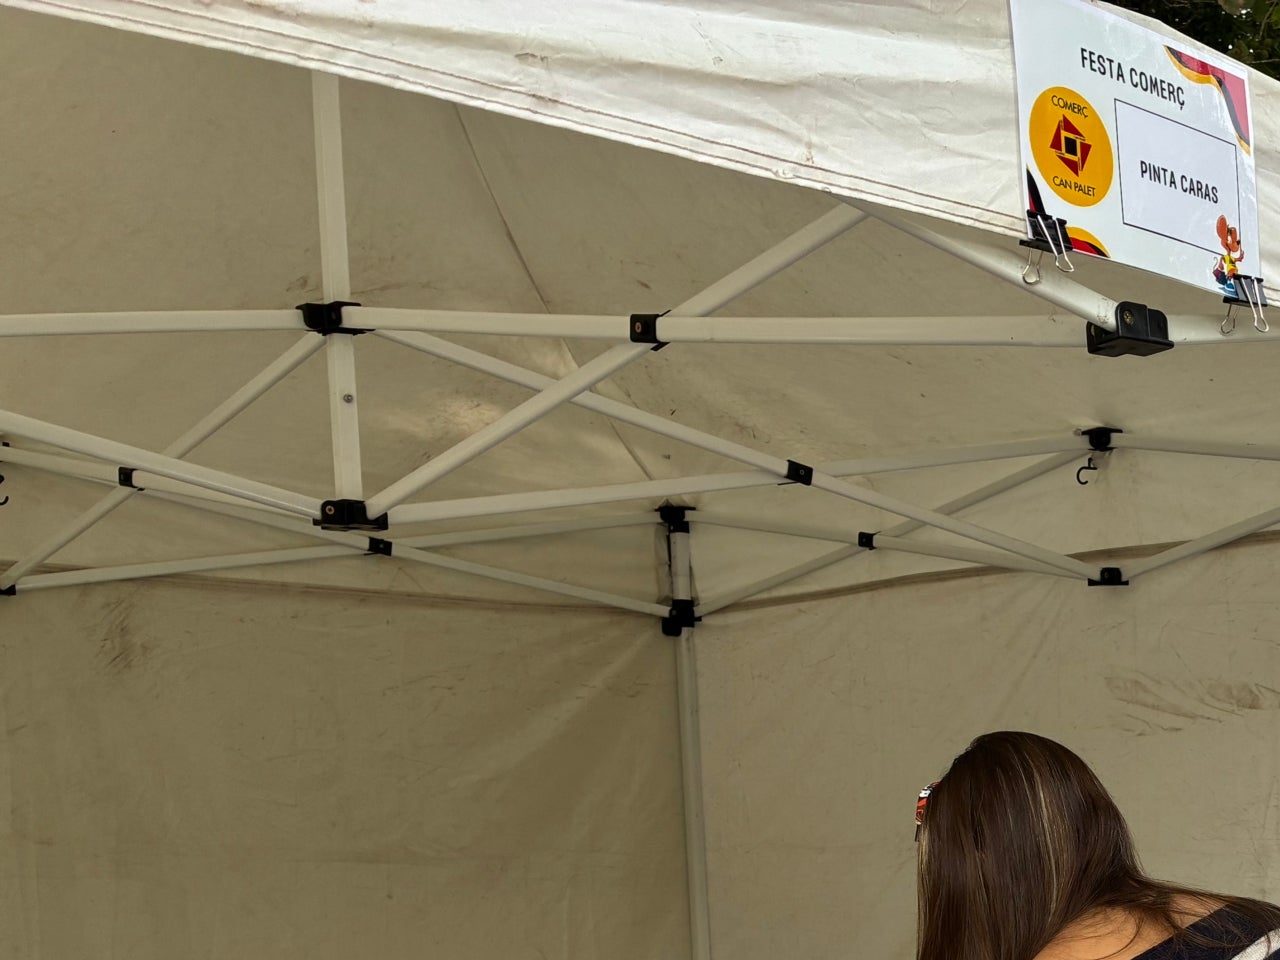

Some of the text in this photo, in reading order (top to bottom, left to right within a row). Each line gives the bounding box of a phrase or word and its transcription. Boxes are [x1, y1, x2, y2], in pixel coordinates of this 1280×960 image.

[1080, 47, 1186, 110] FESTA COMERÇ
[1050, 94, 1089, 119] COMERÇ
[1052, 175, 1097, 198] CAN PALET
[1140, 160, 1219, 204] PINTA CARAS
